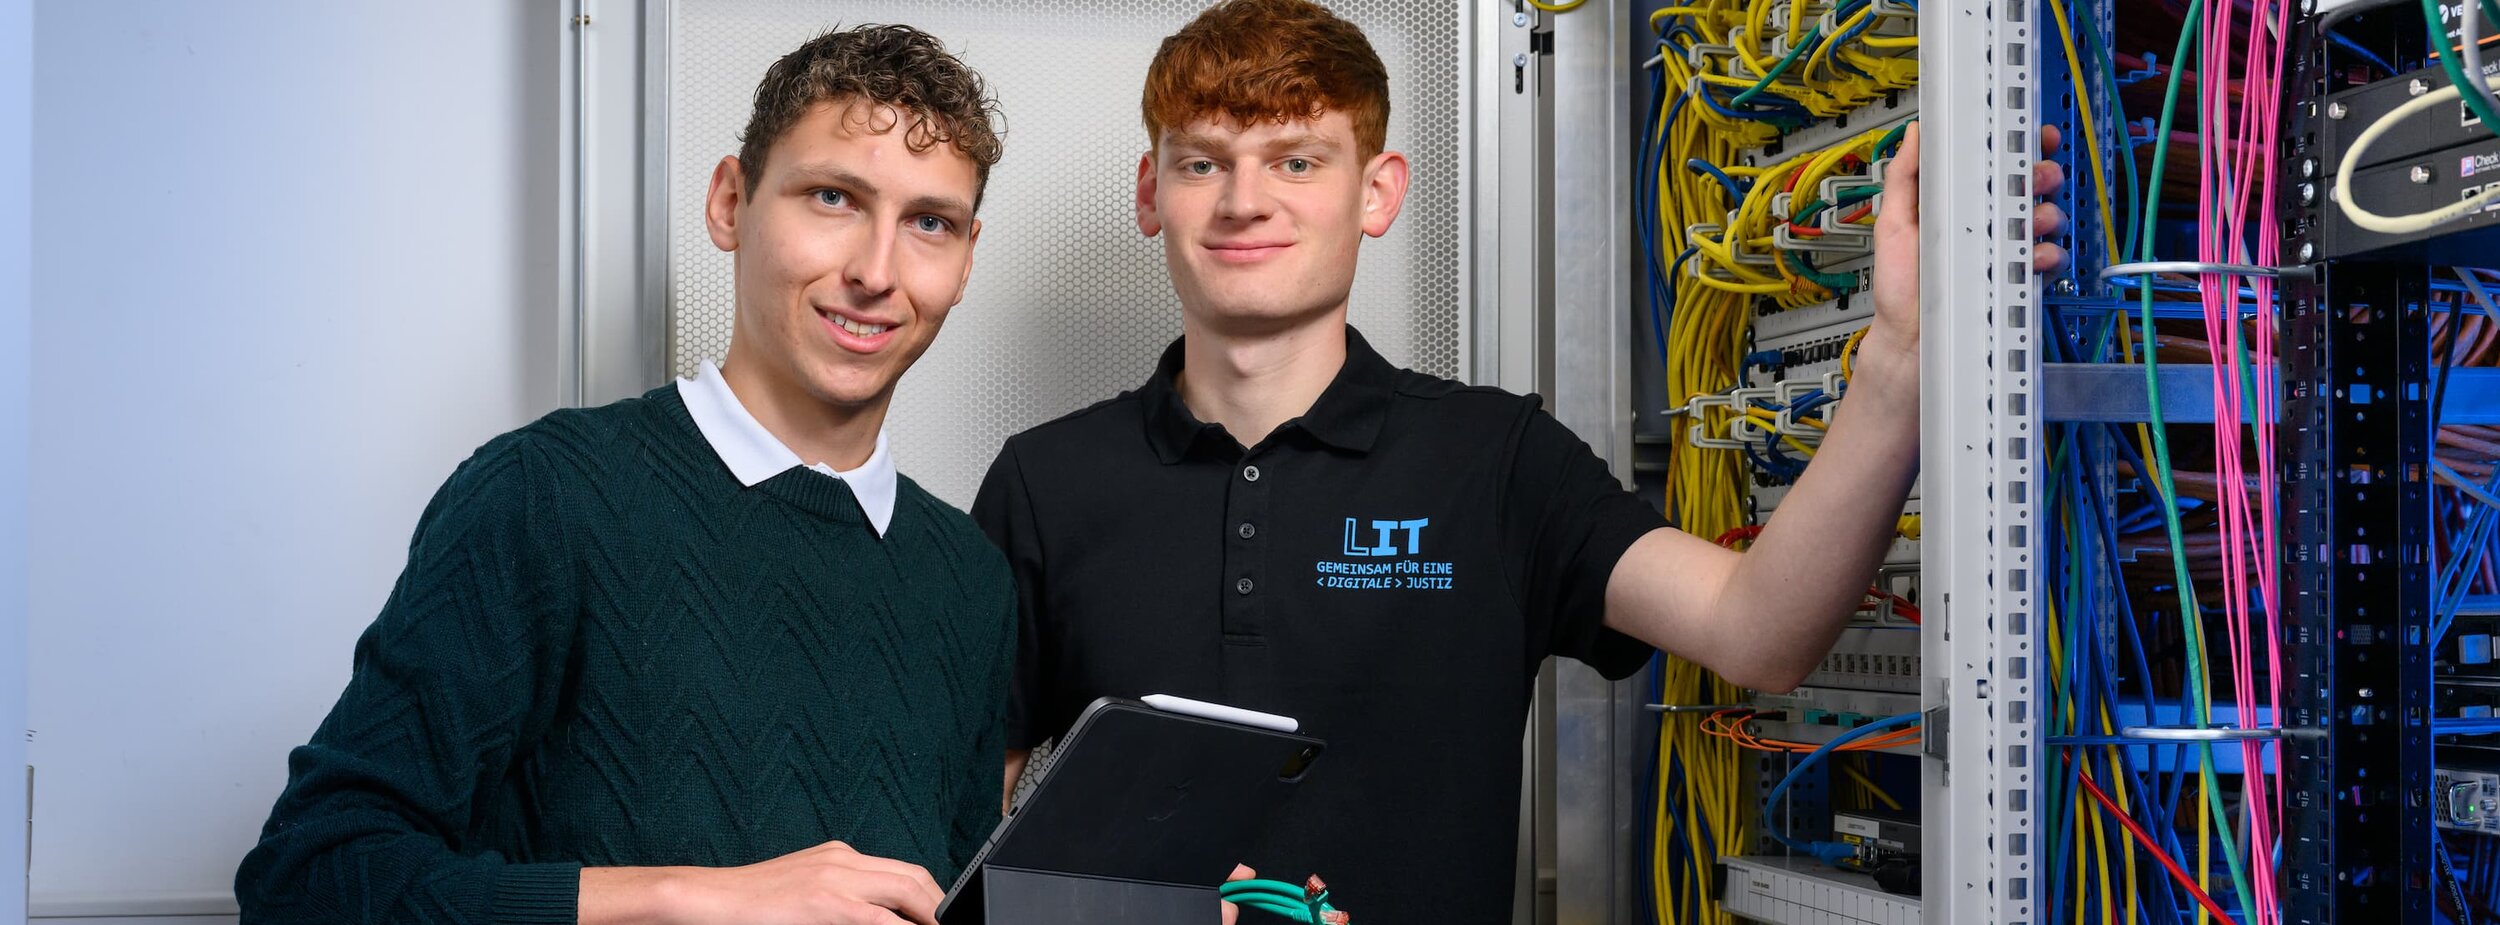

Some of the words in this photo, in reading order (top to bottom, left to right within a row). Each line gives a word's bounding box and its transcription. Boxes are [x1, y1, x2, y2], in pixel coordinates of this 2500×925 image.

[2475, 151, 2499, 168] Check
[1344, 518, 1429, 556] LIT
[1316, 561, 1392, 575] GEMEINSAM
[1395, 560, 1420, 574] FÜR
[1423, 562, 1453, 574] EINE
[1327, 577, 1393, 589] DIGITALE
[1406, 577, 1453, 590] JUSTIZ
